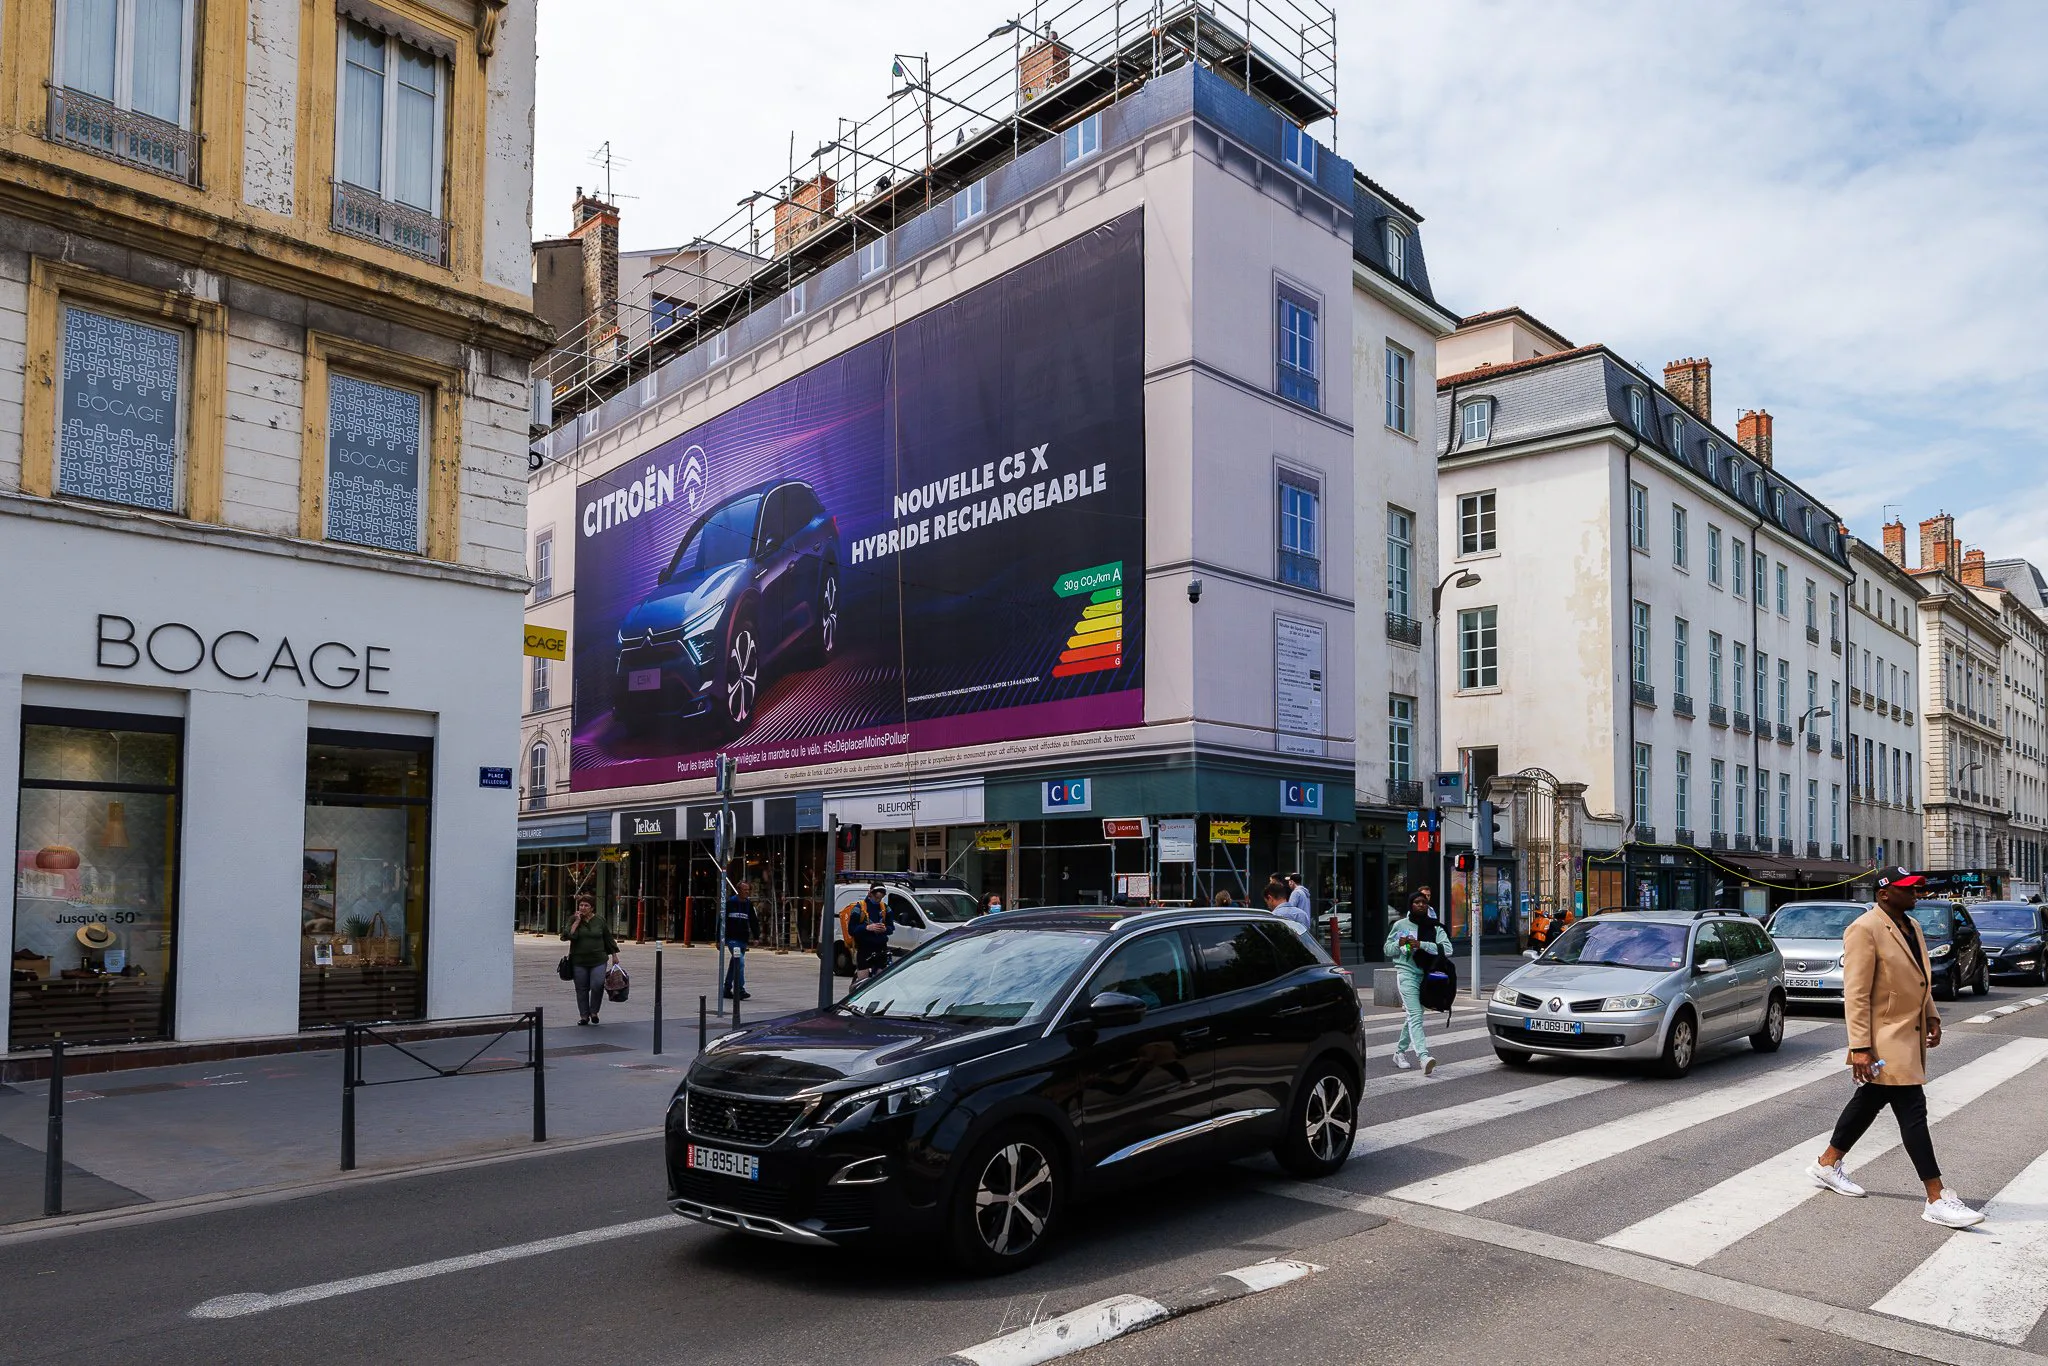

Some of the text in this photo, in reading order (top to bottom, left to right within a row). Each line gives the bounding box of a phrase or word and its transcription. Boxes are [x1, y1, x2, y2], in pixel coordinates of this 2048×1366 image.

[77, 392, 165, 424] BOCAGE
[339, 448, 408, 476] BOCAGE
[893, 443, 1049, 518] NOUVELLE C5 X
[583, 464, 675, 538] CITROËN
[851, 462, 1107, 565] HYBRIDE RECHARGEABLE
[1112, 568, 1121, 583] A
[1115, 588, 1121, 597] B
[96, 613, 391, 695] BOCAGE
[1116, 643, 1121, 651] F
[1114, 657, 1121, 666] G
[1070, 735, 1102, 747] financement
[1103, 734, 1113, 743] des
[1114, 733, 1136, 742] travaux
[677, 761, 690, 773] Pour
[690, 760, 698, 771] les
[698, 758, 714, 772] trajets
[761, 750, 767, 761] la
[768, 748, 790, 760] marche
[790, 748, 799, 758] ou
[800, 744, 806, 757] le
[807, 743, 822, 756] vélo.
[823, 731, 910, 754] #SeDéplacerMoinsPolluer
[1051, 783, 1081, 802] CIC
[1289, 786, 1315, 803] CIC
[877, 798, 921, 814] BLEUFORÊT
[55, 912, 108, 925] Jusqu'à
[1785, 979, 1819, 987] FE-522-TG
[1530, 1019, 1576, 1033] AM-069-DM
[696, 1148, 750, 1176] ET-895-LE
